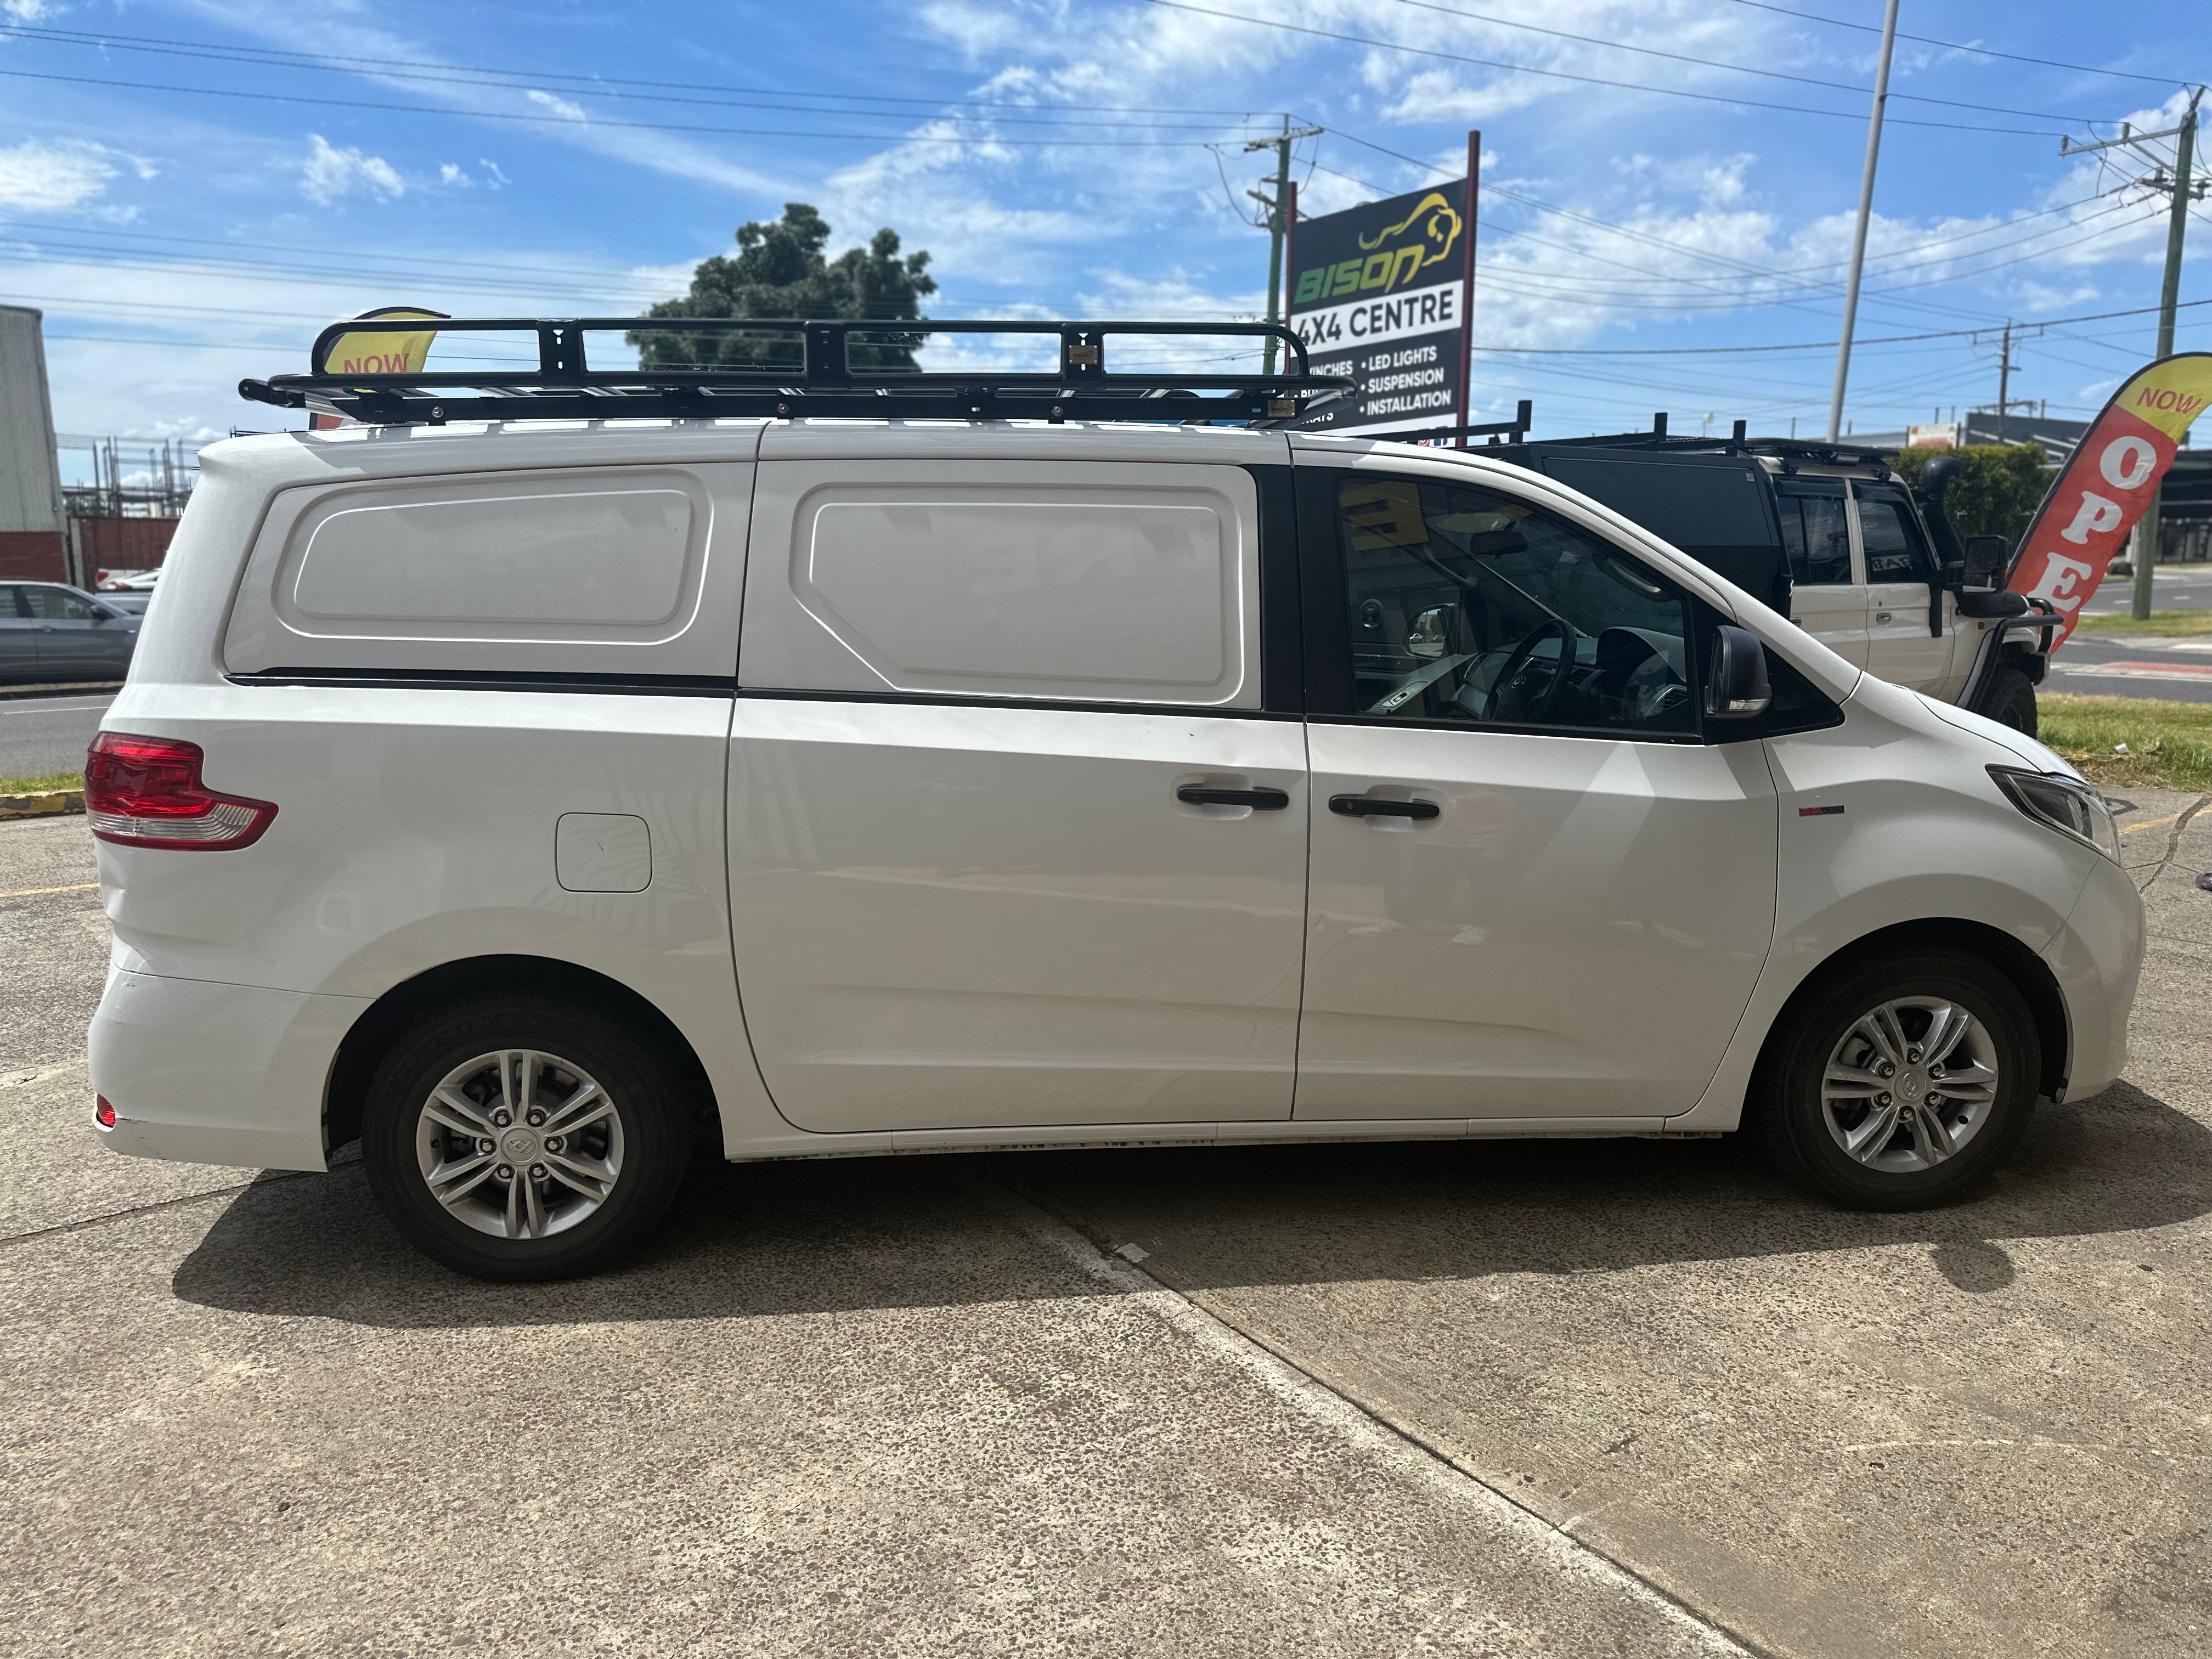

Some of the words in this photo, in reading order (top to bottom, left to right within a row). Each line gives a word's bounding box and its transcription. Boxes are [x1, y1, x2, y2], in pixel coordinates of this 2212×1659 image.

[1293, 244, 1425, 304] BISON
[1297, 312, 1342, 347] 4X4
[1349, 289, 1454, 337] CENTRE
[344, 352, 410, 374] NOW
[1310, 360, 1353, 376] INCHES
[1368, 354, 1391, 371] LED
[1393, 345, 1437, 368] LIGHTS
[1368, 367, 1444, 393] SUSPENSION
[1367, 389, 1452, 416] INSTALLATION
[2136, 386, 2203, 415] NOW
[2027, 435, 2158, 648] OPE
